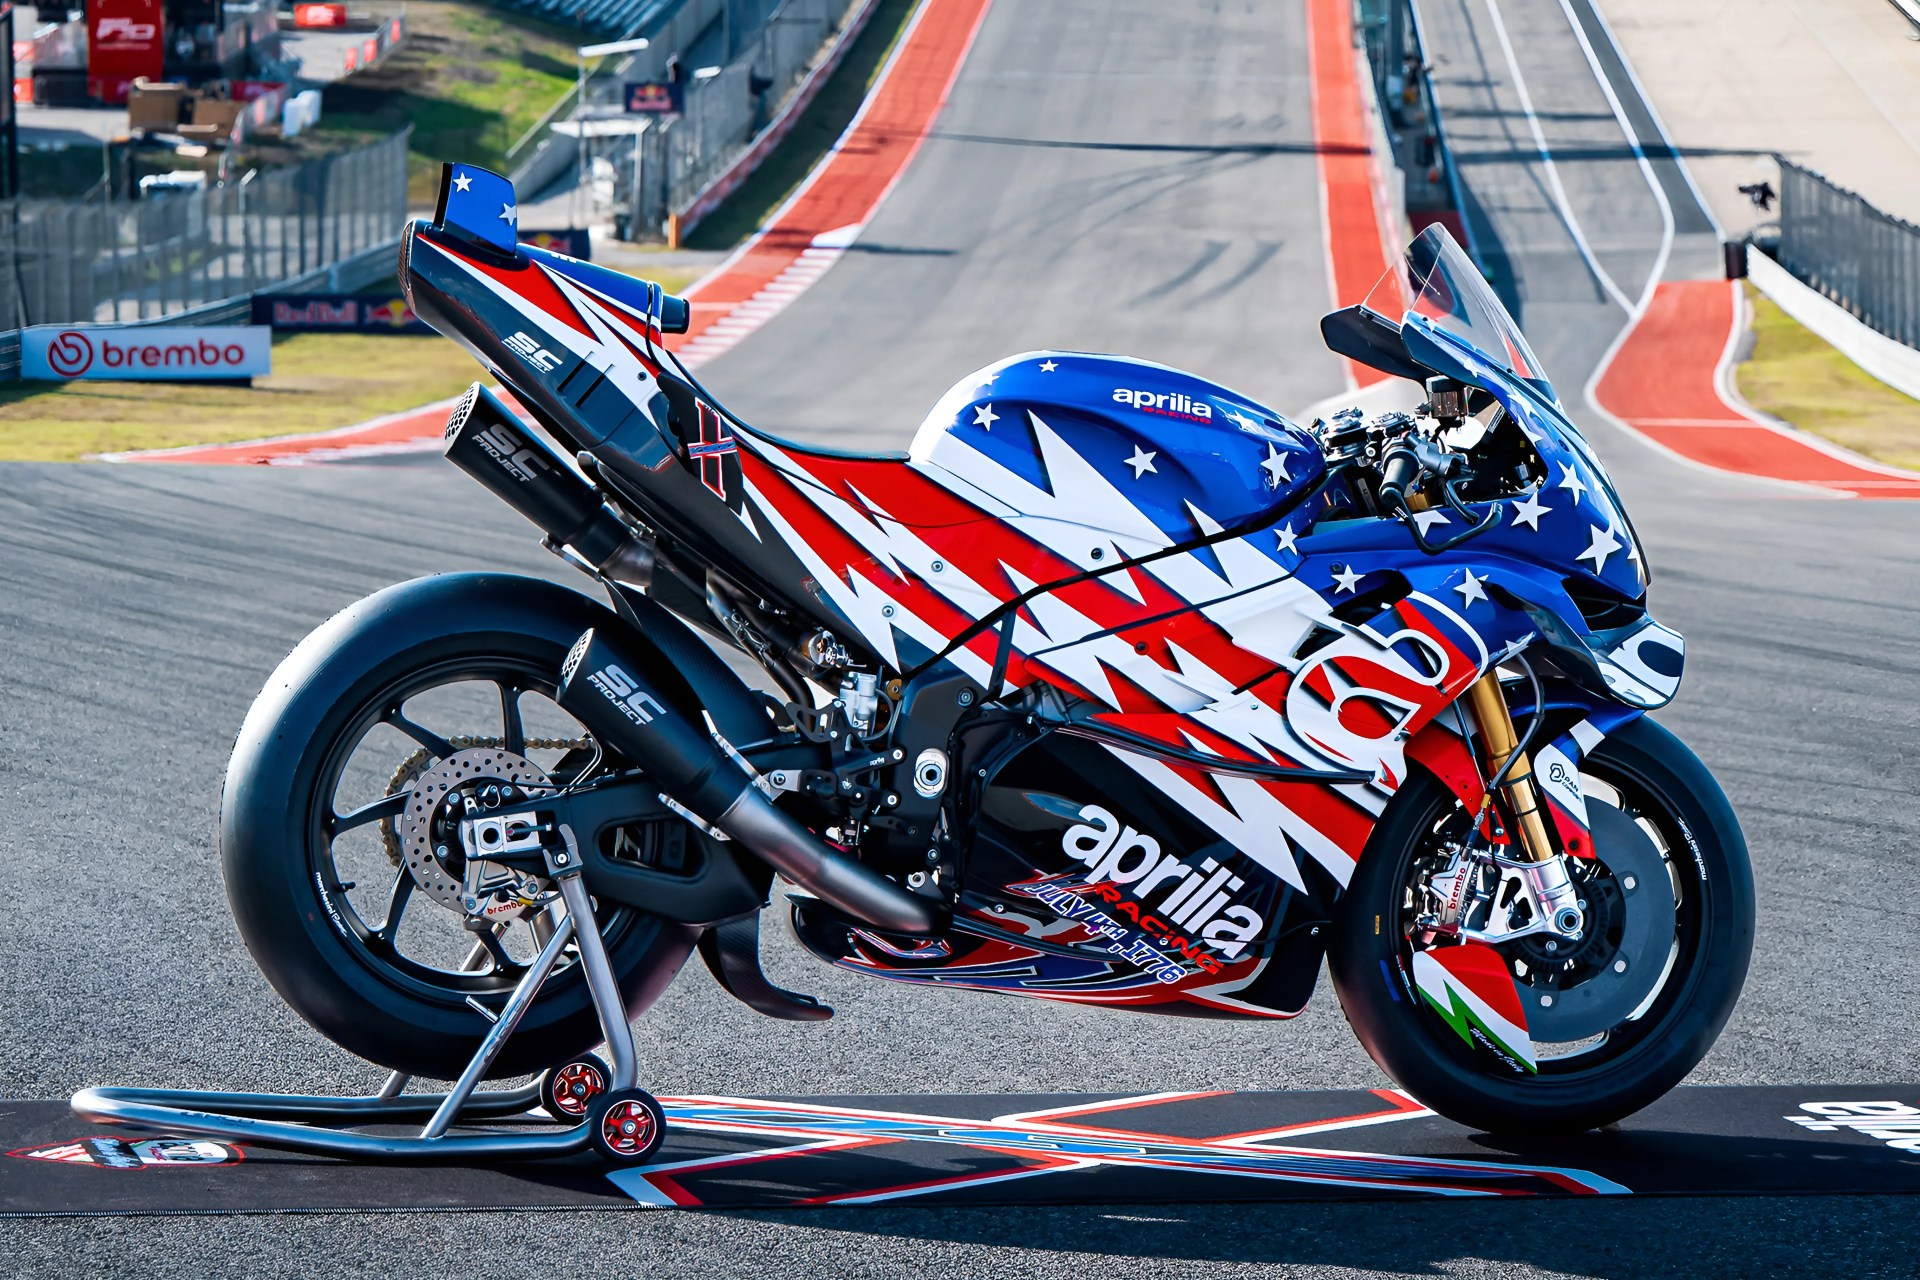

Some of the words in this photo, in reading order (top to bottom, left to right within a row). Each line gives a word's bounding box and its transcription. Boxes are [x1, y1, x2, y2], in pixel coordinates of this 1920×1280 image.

[103, 339, 245, 367] brembo
[507, 331, 564, 370] SC
[1112, 388, 1212, 419] aprilia
[471, 434, 530, 483] PROJECT
[480, 423, 551, 480] SC
[586, 674, 647, 726] PROJECT
[594, 663, 667, 723] SC
[1024, 884, 1095, 917] JULY
[1061, 804, 1264, 960] aprilia
[1447, 867, 1467, 910] brembo
[1095, 883, 1225, 976] RACING
